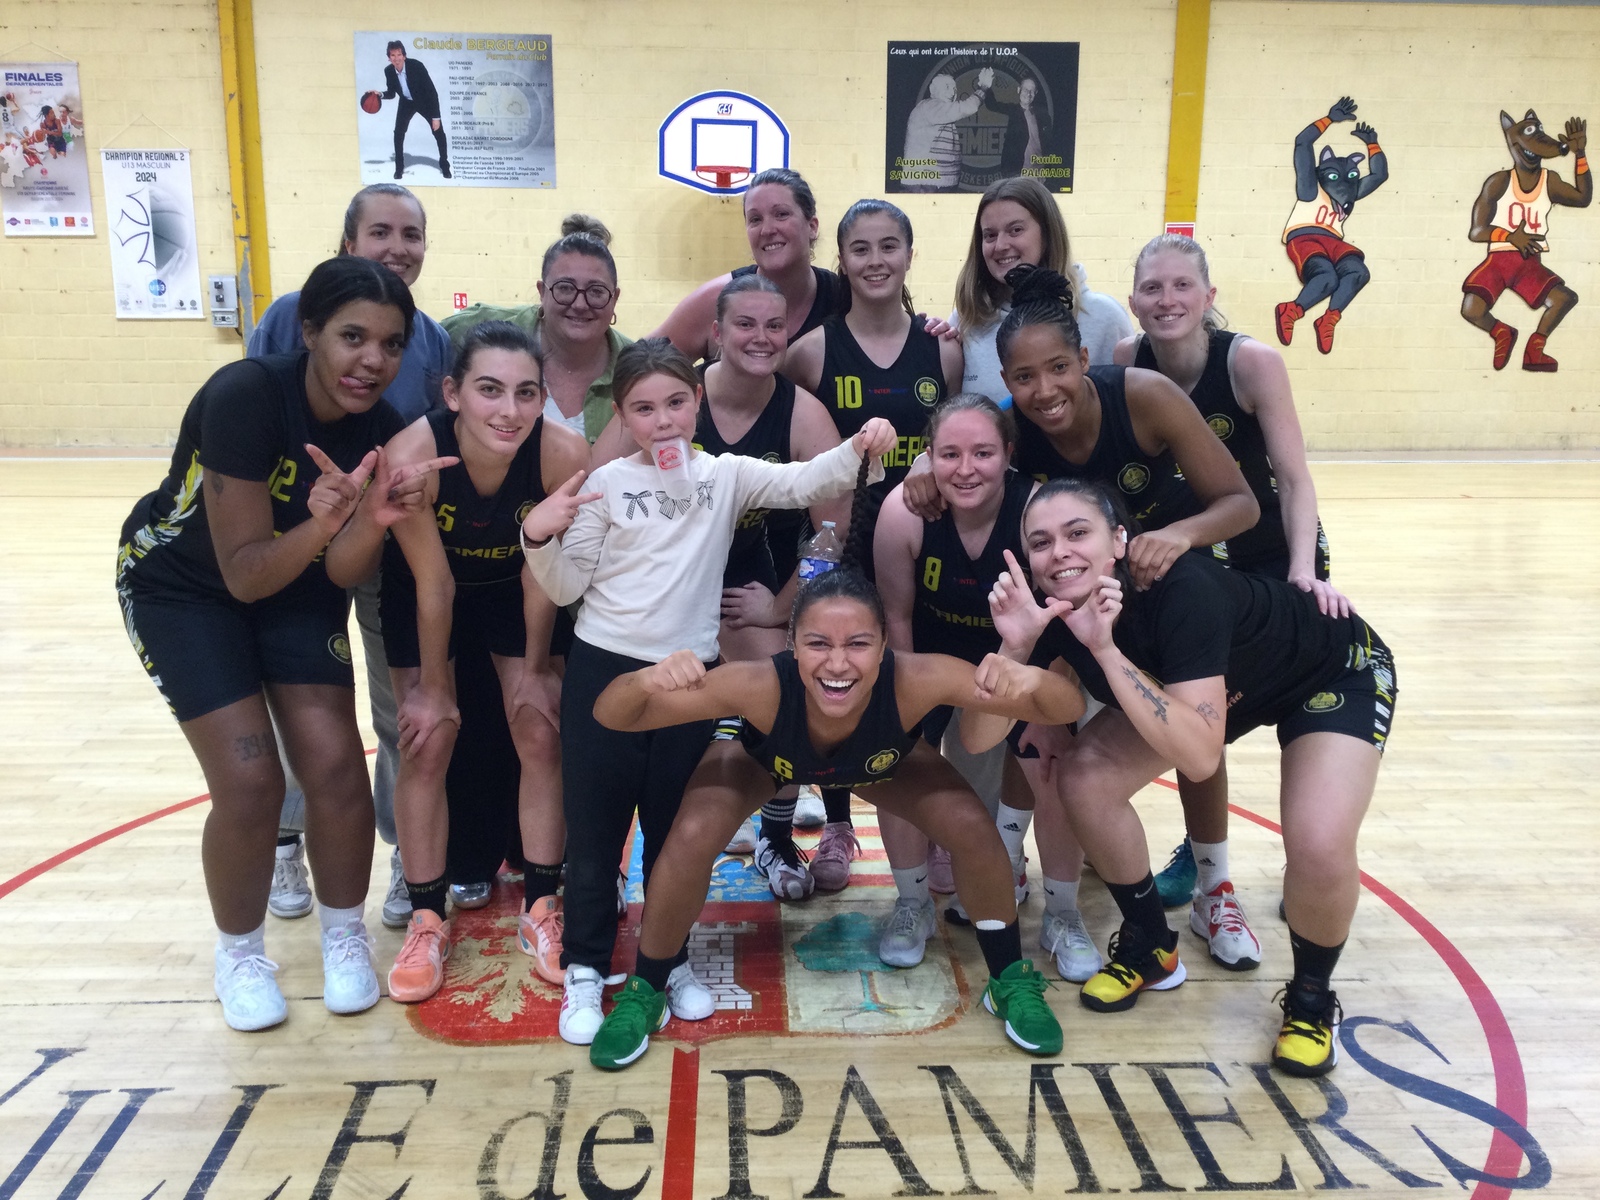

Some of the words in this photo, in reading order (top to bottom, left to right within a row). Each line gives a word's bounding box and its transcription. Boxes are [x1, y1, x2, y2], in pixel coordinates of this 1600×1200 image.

[413, 37, 462, 50] Claude
[466, 39, 548, 51] BERGEAUD
[889, 47, 907, 55] Ceux
[908, 48, 919, 57] qui
[934, 47, 949, 55] écrit
[996, 47, 1018, 56] U.O.P.
[5, 73, 63, 82] FINALES
[105, 152, 142, 161] CHAMPION
[145, 152, 178, 161] REGIONAL
[180, 153, 185, 161] 2
[894, 156, 938, 167] Auguste
[1031, 153, 1062, 164] Paulin
[135, 172, 157, 182] 2024
[890, 170, 941, 180] SAVIGNOL
[1021, 167, 1071, 178] PALMADE
[1508, 201, 1541, 233] 04
[834, 375, 863, 409] 10
[437, 503, 457, 532] 5
[923, 556, 942, 592] 8
[774, 755, 793, 780] 6
[476, 1069, 654, 1200] de
[710, 1014, 1552, 1200] PAMIERS
